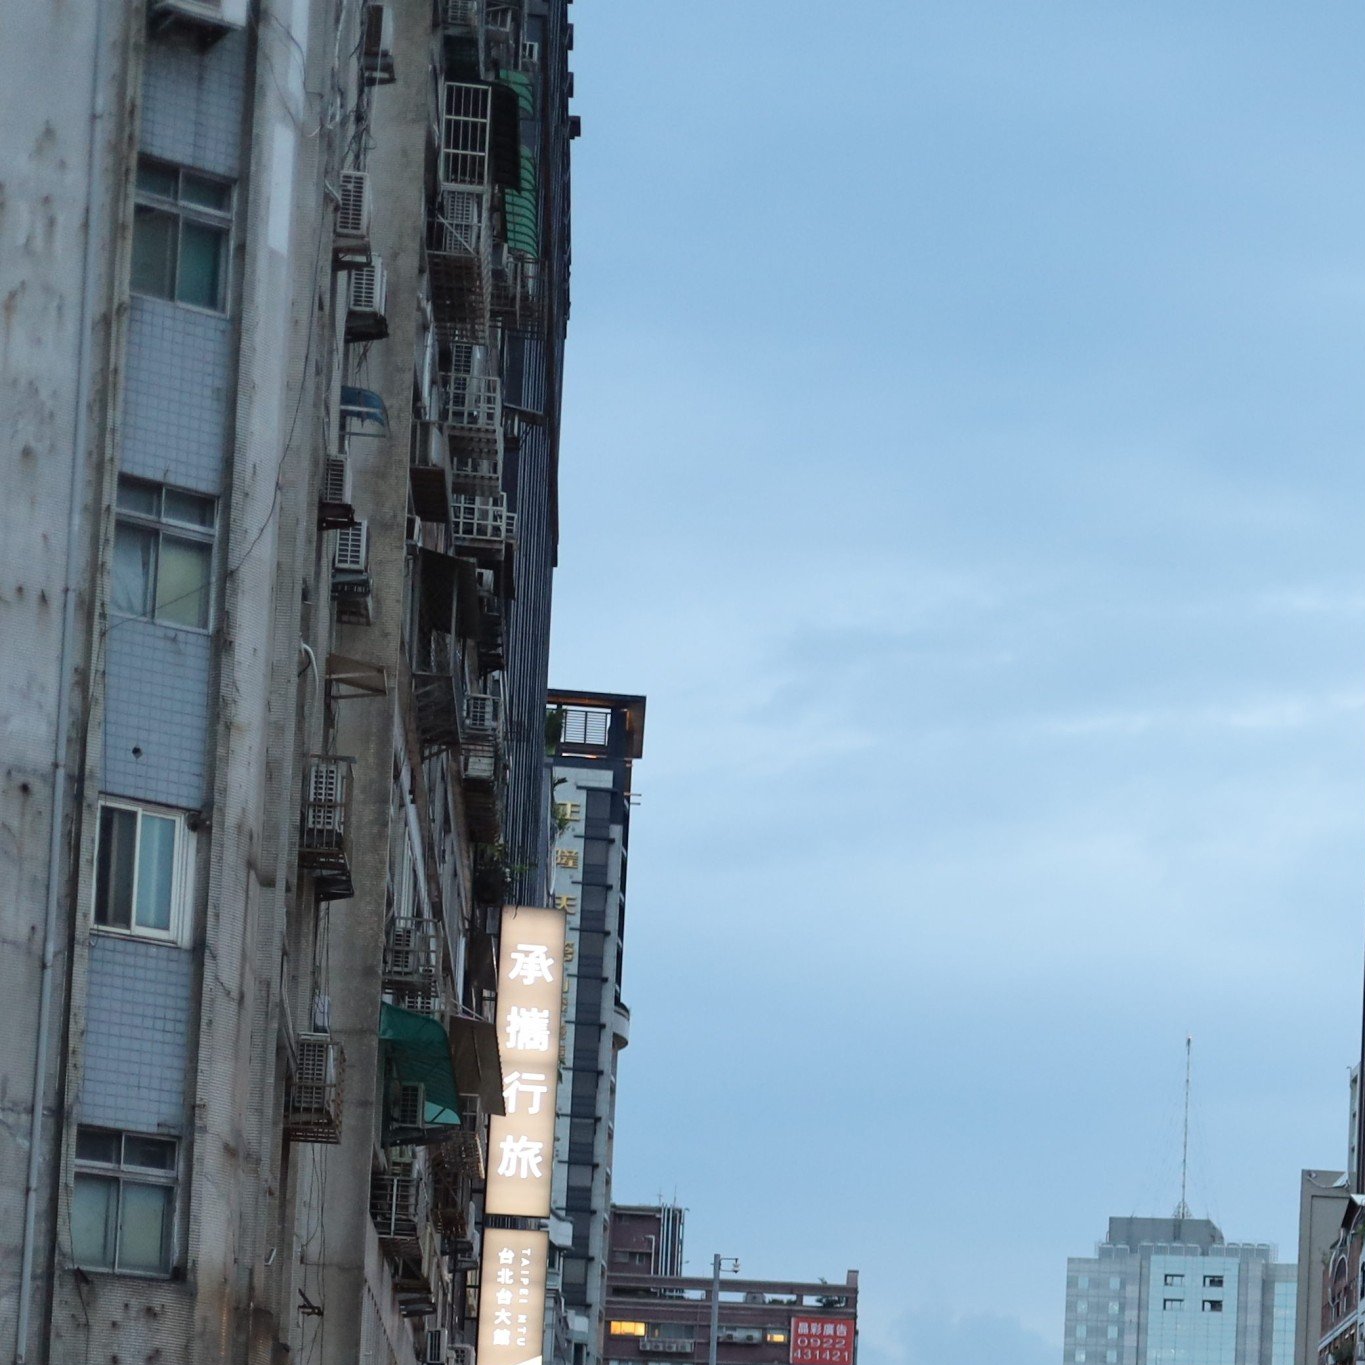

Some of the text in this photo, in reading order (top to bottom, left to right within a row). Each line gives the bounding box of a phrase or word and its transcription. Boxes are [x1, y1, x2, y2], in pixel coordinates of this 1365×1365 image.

[497, 944, 555, 1179] 承攜行旅
[518, 1248, 532, 1304] TAIPEI
[793, 1348, 849, 1362] 431421
[797, 1337, 846, 1349] 0922
